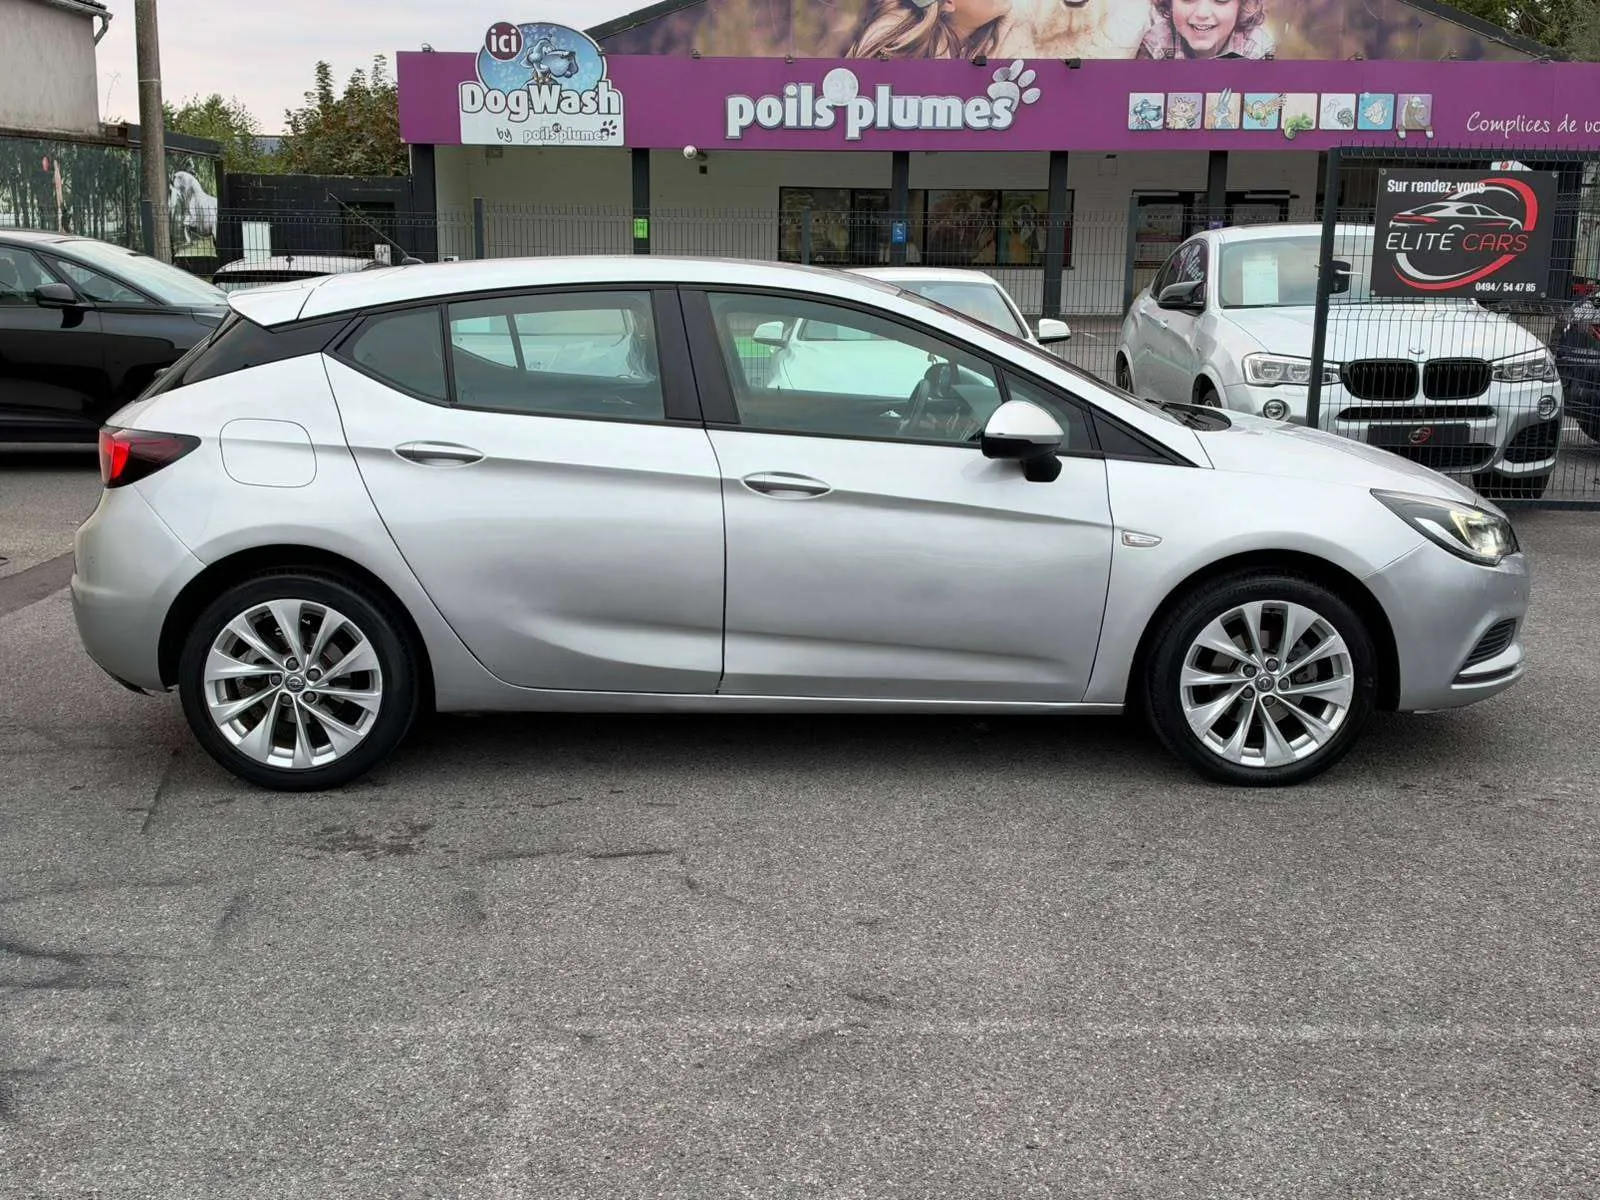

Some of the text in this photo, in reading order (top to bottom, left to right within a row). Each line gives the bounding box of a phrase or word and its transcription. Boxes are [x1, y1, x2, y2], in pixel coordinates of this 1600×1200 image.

[490, 28, 517, 53] ici
[461, 80, 621, 122] DogWash
[725, 83, 837, 140] poils
[845, 83, 1015, 140] plumes
[496, 127, 512, 143] by
[523, 126, 557, 143] poils
[559, 127, 610, 143] plumes
[1466, 111, 1551, 139] Complices
[1557, 113, 1578, 133] de
[1387, 179, 1486, 194] Sur rendez-vous
[1385, 232, 1529, 252] ELITE CARS
[1503, 282, 1513, 292] 54
[1514, 282, 1525, 292] 47
[1525, 282, 1537, 292] 85
